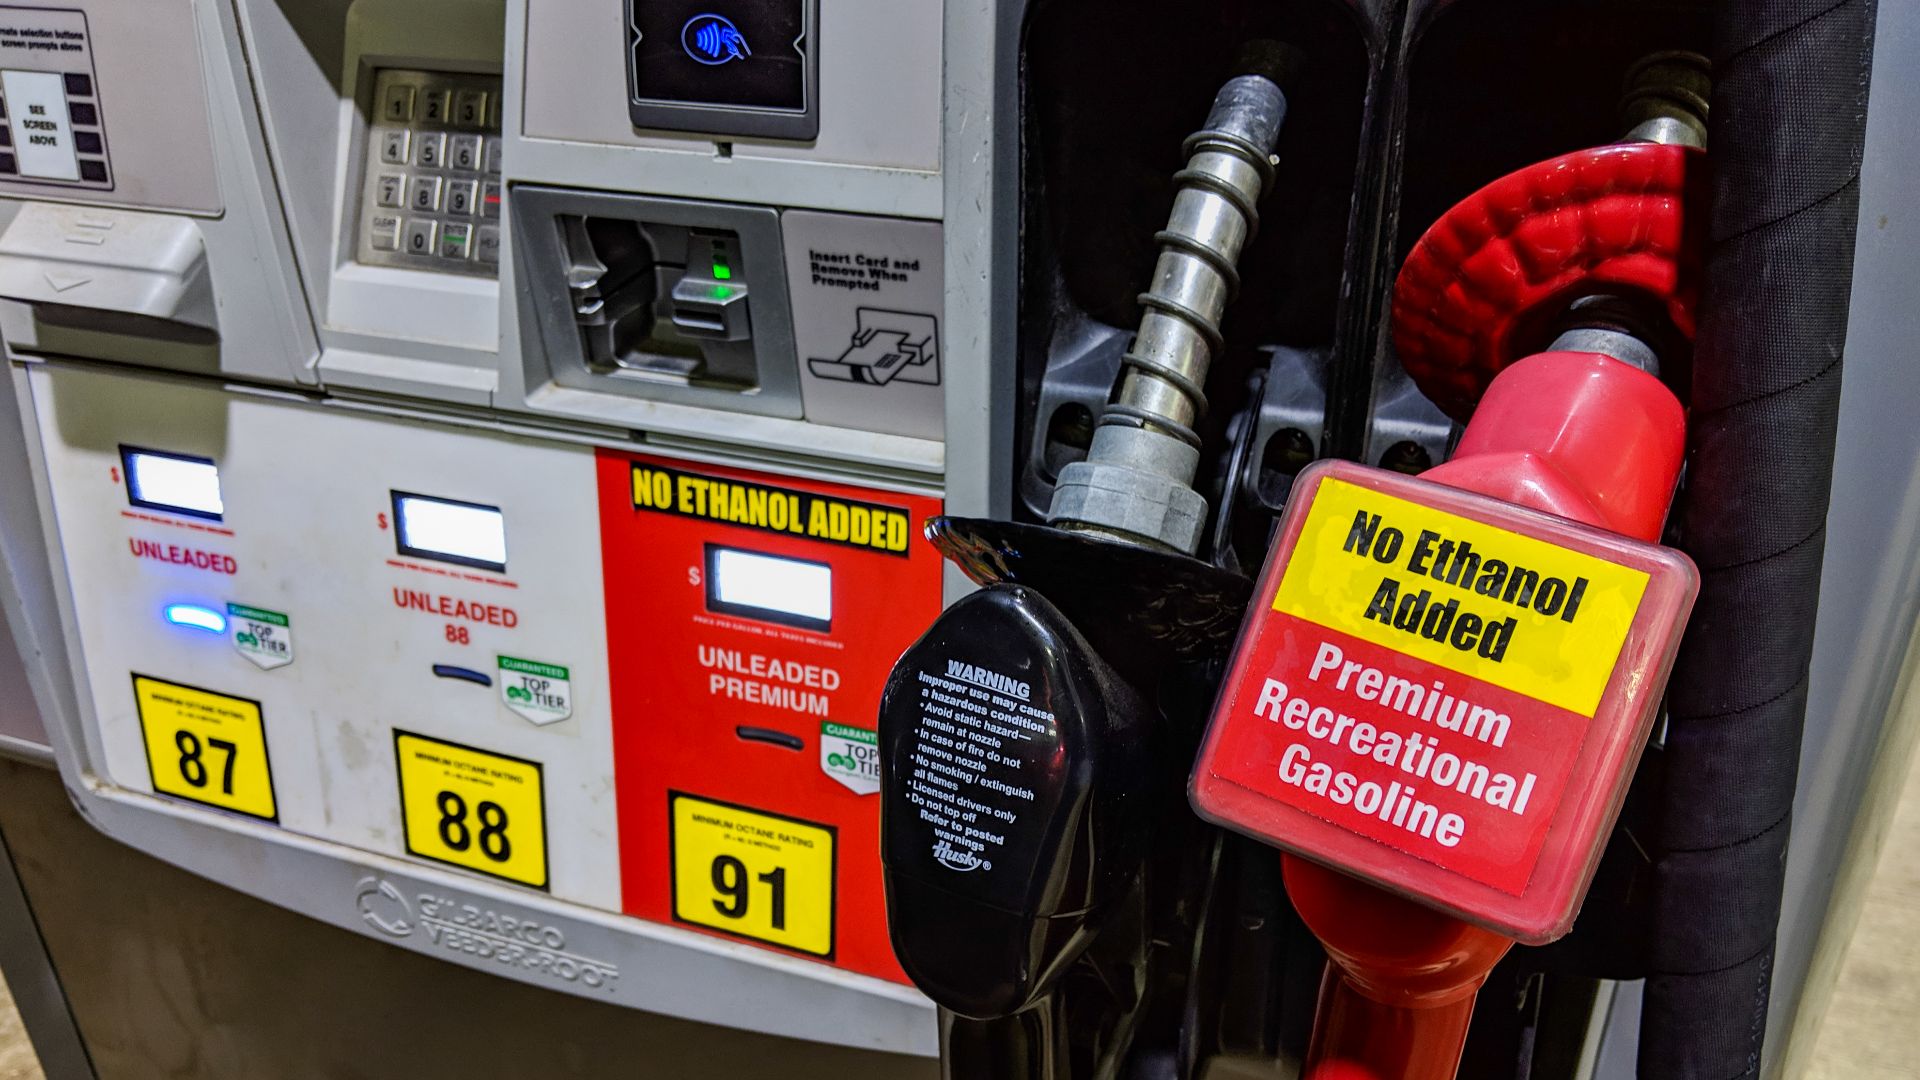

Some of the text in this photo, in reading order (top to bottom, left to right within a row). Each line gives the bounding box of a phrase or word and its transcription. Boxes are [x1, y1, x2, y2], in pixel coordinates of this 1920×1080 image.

[1, 40, 83, 52] screen prompts above
[20, 28, 53, 38] selection
[55, 30, 84, 40] buttons
[28, 104, 46, 116] SEE
[393, 101, 400, 116] 1
[429, 103, 438, 119] 2
[465, 105, 474, 121] 3
[22, 119, 58, 132] SCREEN
[29, 135, 57, 147] ABOVE
[388, 144, 397, 159] 4
[424, 146, 433, 161] 5
[460, 149, 469, 165] 6
[385, 186, 394, 202] 7
[420, 190, 428, 206] 8
[456, 194, 465, 209] 9
[414, 233, 424, 249] 0
[809, 250, 920, 271] Insert Card and
[810, 262, 908, 282] Remove When
[812, 274, 880, 291] Prompted
[377, 512, 388, 530] $
[632, 467, 909, 552] NO ETHANOL ADDED
[129, 537, 237, 576] UNLEADED
[1342, 509, 1589, 624] No Ethanol
[688, 566, 701, 586] $
[393, 587, 518, 629] UNLEADED
[1363, 578, 1518, 663] Added
[445, 623, 470, 646] 88
[698, 644, 841, 691] UNLEADED
[948, 659, 1030, 698] WARNING
[521, 676, 550, 692] TOP
[710, 674, 830, 717] PREMIUM
[918, 671, 1055, 721] Improper use may cause
[1307, 641, 1513, 749] Premium
[921, 688, 1045, 734] a hazardous condition
[925, 702, 953, 719] Avoid
[954, 712, 982, 728] static
[922, 716, 1001, 749] remain at nozzle
[1253, 678, 1538, 816] Recreational
[175, 729, 237, 796] 87
[917, 743, 987, 773] remove nozzle
[920, 728, 1021, 769] In case of fire do not
[914, 768, 959, 791] all flames
[916, 754, 1034, 801] No smoking / extinguish
[911, 793, 977, 823] Do not top off
[913, 780, 1017, 824] Licensed drivers only
[1278, 743, 1466, 848] Gasoline
[436, 790, 512, 863] 88
[692, 814, 734, 829] MINIMUM
[736, 823, 775, 840] OCTANE
[778, 832, 815, 849] RATING
[920, 809, 1005, 846] Refer to posted
[934, 827, 985, 852] warnings
[710, 854, 787, 932] 91
[417, 894, 565, 950] GILBARCO
[421, 920, 619, 992] VEEDER-ROOT
